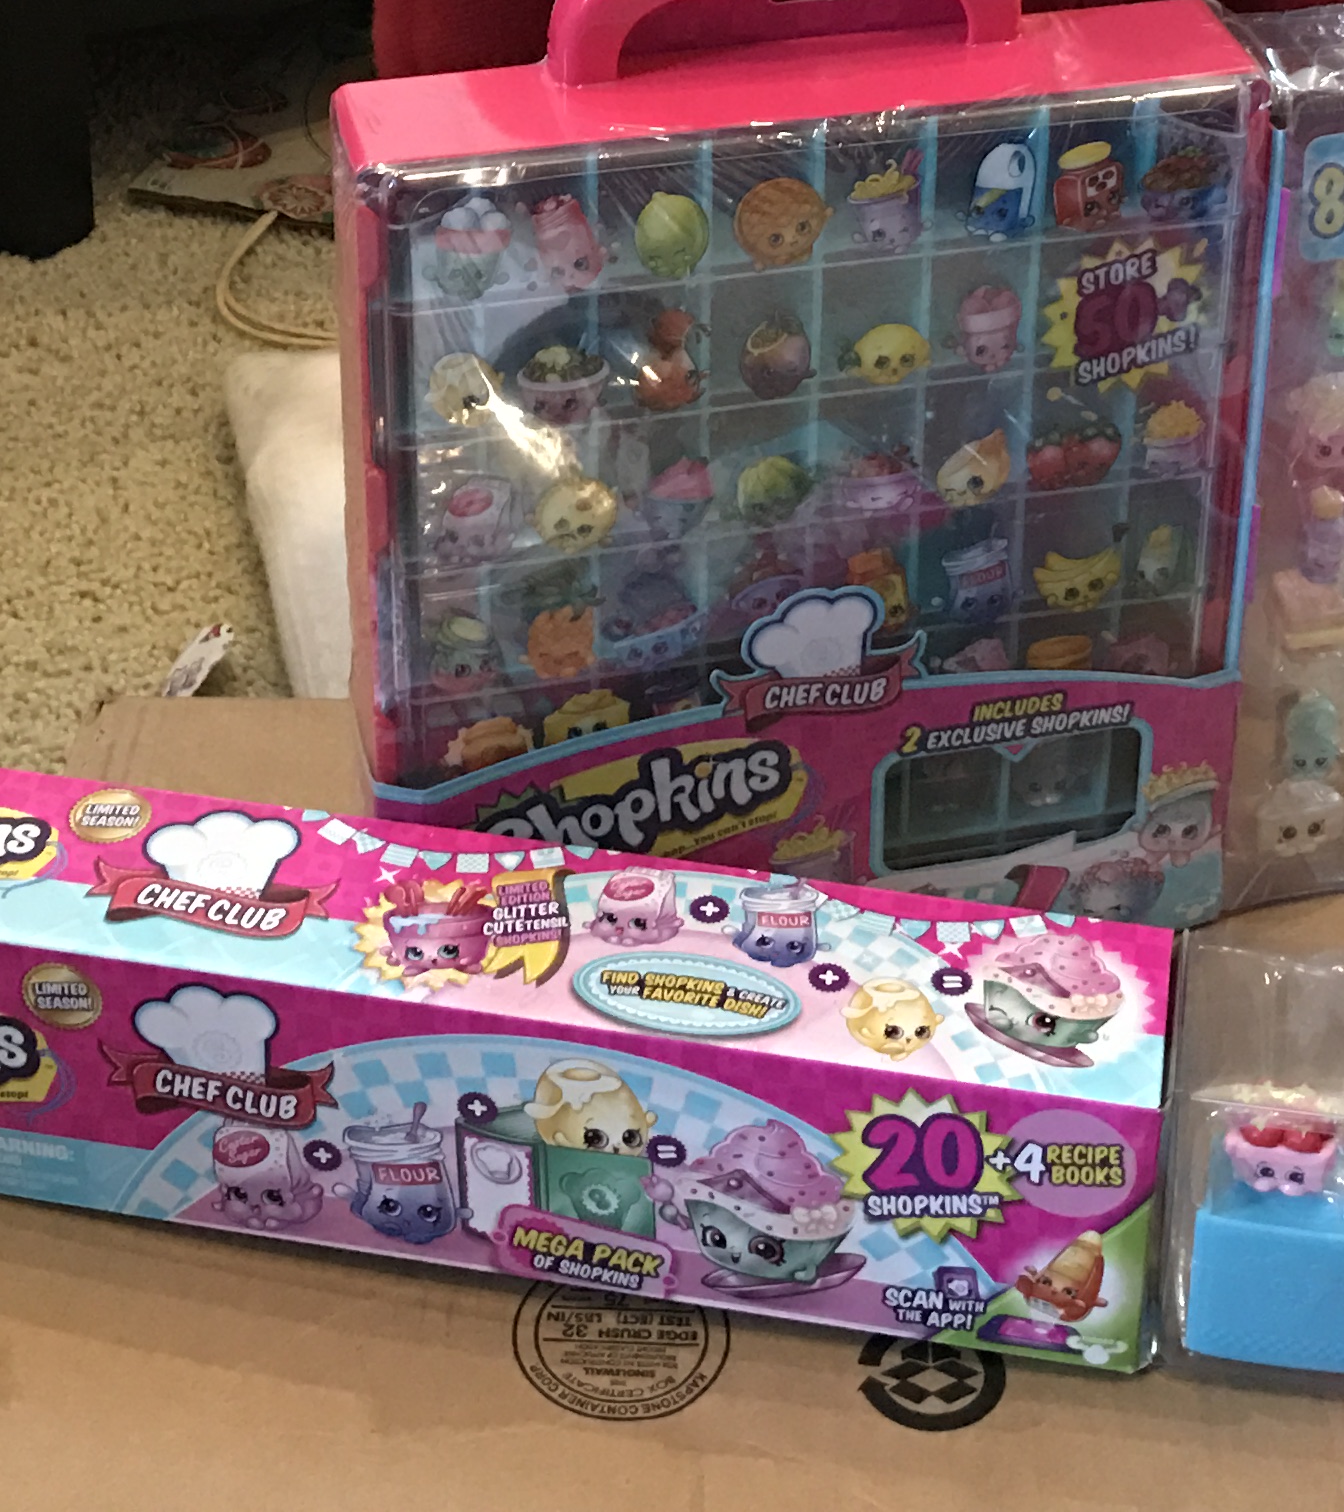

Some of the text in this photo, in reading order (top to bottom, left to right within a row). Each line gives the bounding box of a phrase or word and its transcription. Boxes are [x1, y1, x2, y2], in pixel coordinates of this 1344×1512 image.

[1080, 252, 1157, 294] STORE
[1075, 281, 1157, 358] 50
[1077, 326, 1199, 384] SHOPKINS!
[764, 677, 887, 710] CHEF CLUB
[973, 692, 1064, 723] INCLUDES
[901, 704, 1131, 754] 2 EXCLUSIVE SHOPKINS!
[80, 815, 141, 828] SEASON!
[85, 803, 141, 815] LIMITED
[136, 883, 288, 931] CHEF CLUB
[492, 901, 560, 921] GLITTER
[760, 913, 811, 927] FLOUR
[32, 981, 87, 997] LIMITED
[36, 994, 93, 1011] SEASON!
[601, 970, 640, 985] FIND
[643, 973, 726, 996] SHOPKINS
[738, 989, 788, 1010] CREATE
[609, 984, 771, 1019] YOUR FAVORITE DISH!
[156, 1069, 298, 1121] CHEF CLUB
[860, 1113, 984, 1192] 20
[1047, 1145, 1121, 1166] RECIPE
[376, 1166, 440, 1184] FLOUR
[1050, 1166, 1124, 1186] BOOKS
[512, 1226, 664, 1279] MEGA PACK
[532, 1254, 642, 1290] OF SHOPKINS
[884, 1287, 986, 1313] SCAN WITH
[546, 1311, 692, 1327] TEST (ECT) LBS/IN
[561, 1323, 698, 1341] EDGE CRUSH 32
[896, 1308, 974, 1330] THE APP!
[561, 1371, 645, 1398] CERTIFICATE
[642, 1371, 708, 1414] KAPSTONE
[557, 1390, 639, 1416] CONTAINER
